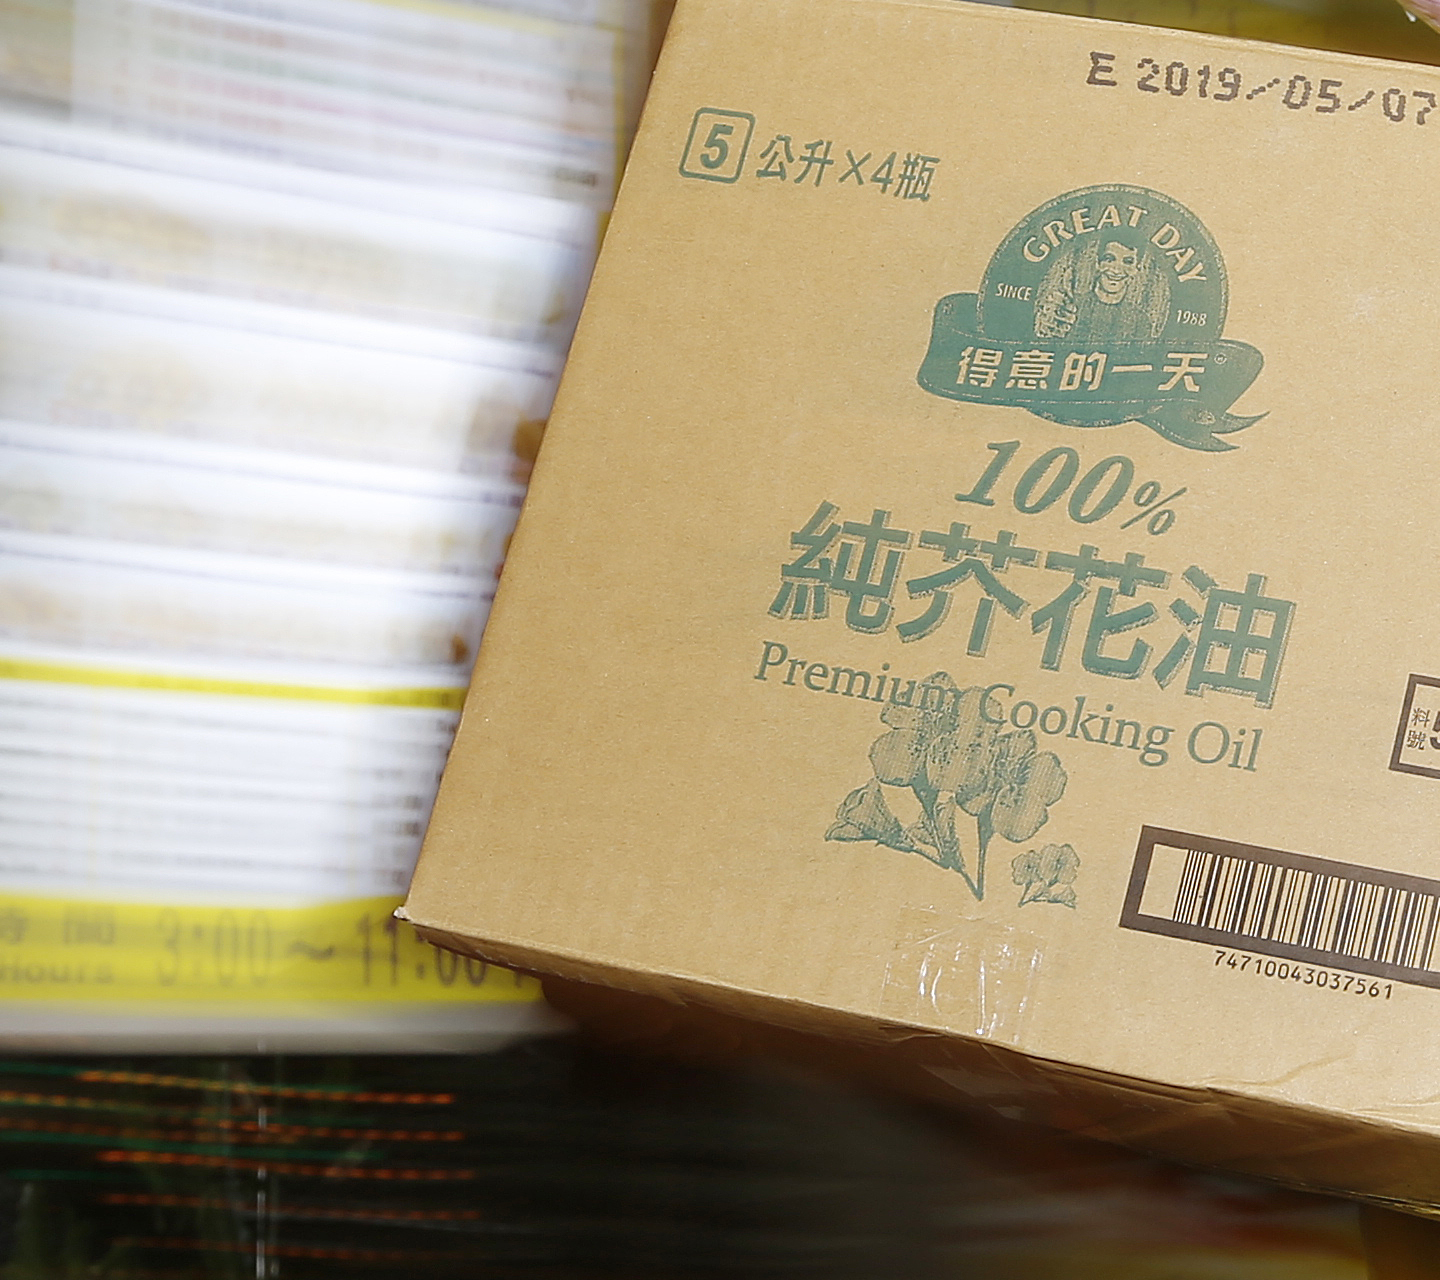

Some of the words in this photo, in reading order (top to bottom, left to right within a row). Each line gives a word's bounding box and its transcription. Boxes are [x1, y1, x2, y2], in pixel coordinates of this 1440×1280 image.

[1085, 51, 1117, 87] E
[1136, 58, 1437, 126] 2019/05/07
[1022, 204, 1149, 264] GREAT
[1150, 222, 1208, 284] DAY
[995, 282, 1032, 302] SINCE
[1175, 309, 1207, 327] 1988
[955, 344, 1210, 394] 得意的一天
[954, 439, 1188, 536] 100%
[766, 499, 1298, 711] 純芥花油
[753, 640, 960, 718] Premium
[978, 682, 1175, 768] Cooking
[1186, 719, 1264, 773] Oil
[1213, 949, 1394, 1001] 74710043037561
